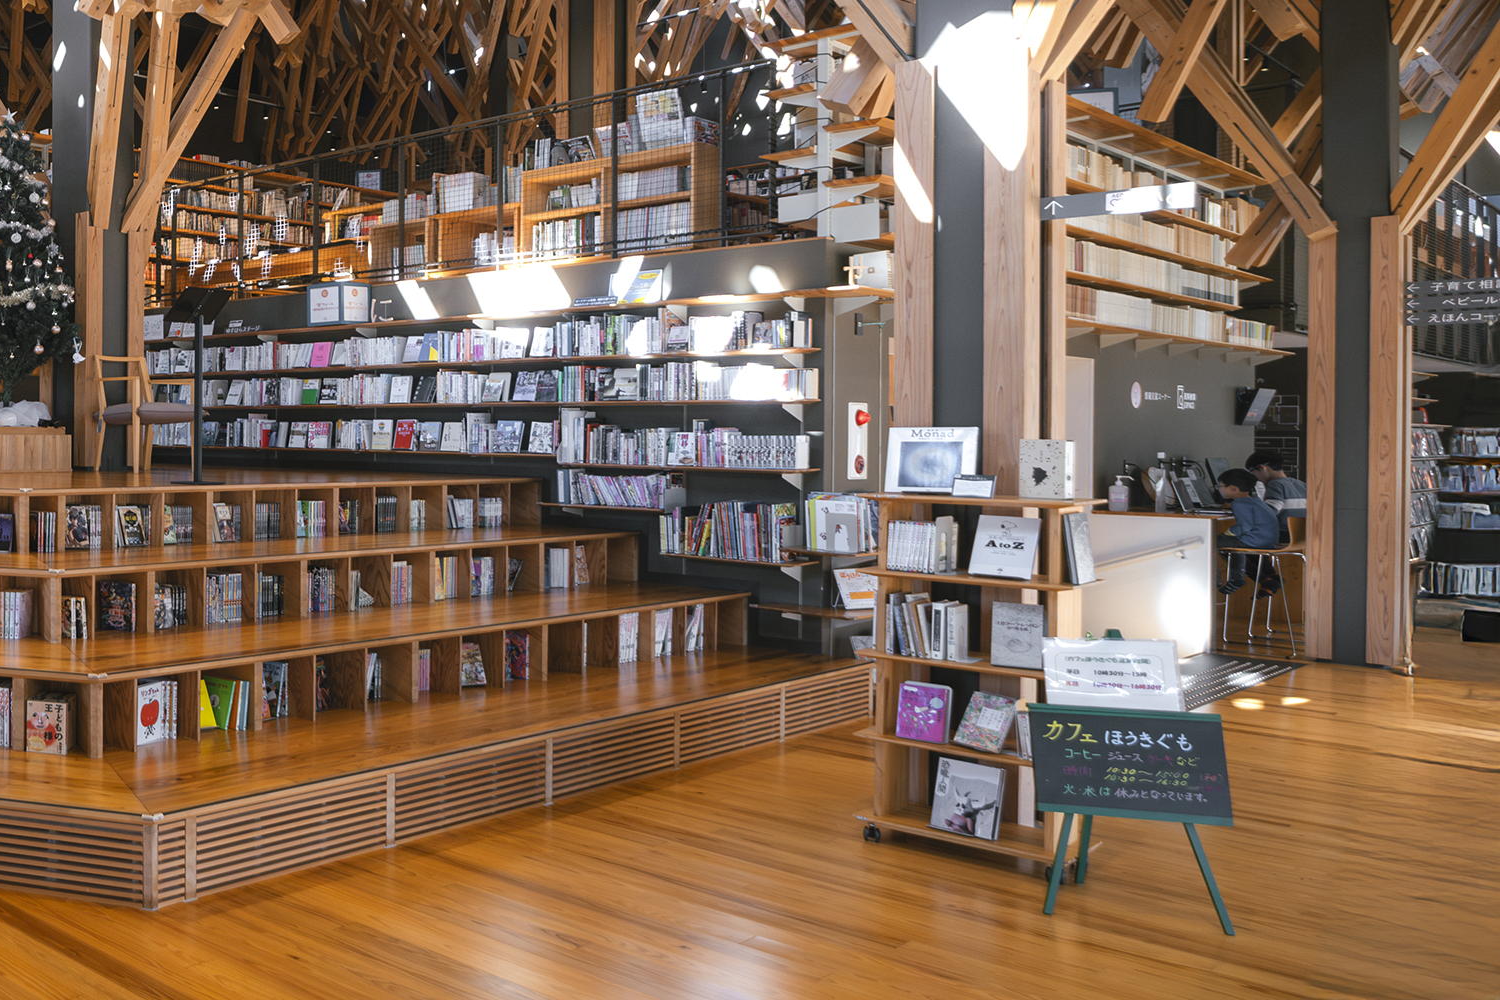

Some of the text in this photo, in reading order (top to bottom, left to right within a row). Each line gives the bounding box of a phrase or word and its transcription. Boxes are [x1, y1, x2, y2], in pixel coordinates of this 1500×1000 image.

[1441, 296, 1500, 306] ベビール
[1428, 312, 1500, 323] えほんコー
[910, 428, 955, 438] Monad
[985, 540, 997, 549] A
[1013, 541, 1025, 550] Z
[54, 704, 64, 741] 子どもの
[1042, 720, 1192, 751] カフェ ほうきぐも
[1065, 748, 1101, 760] コーヒー
[1107, 751, 1144, 763] ジュース
